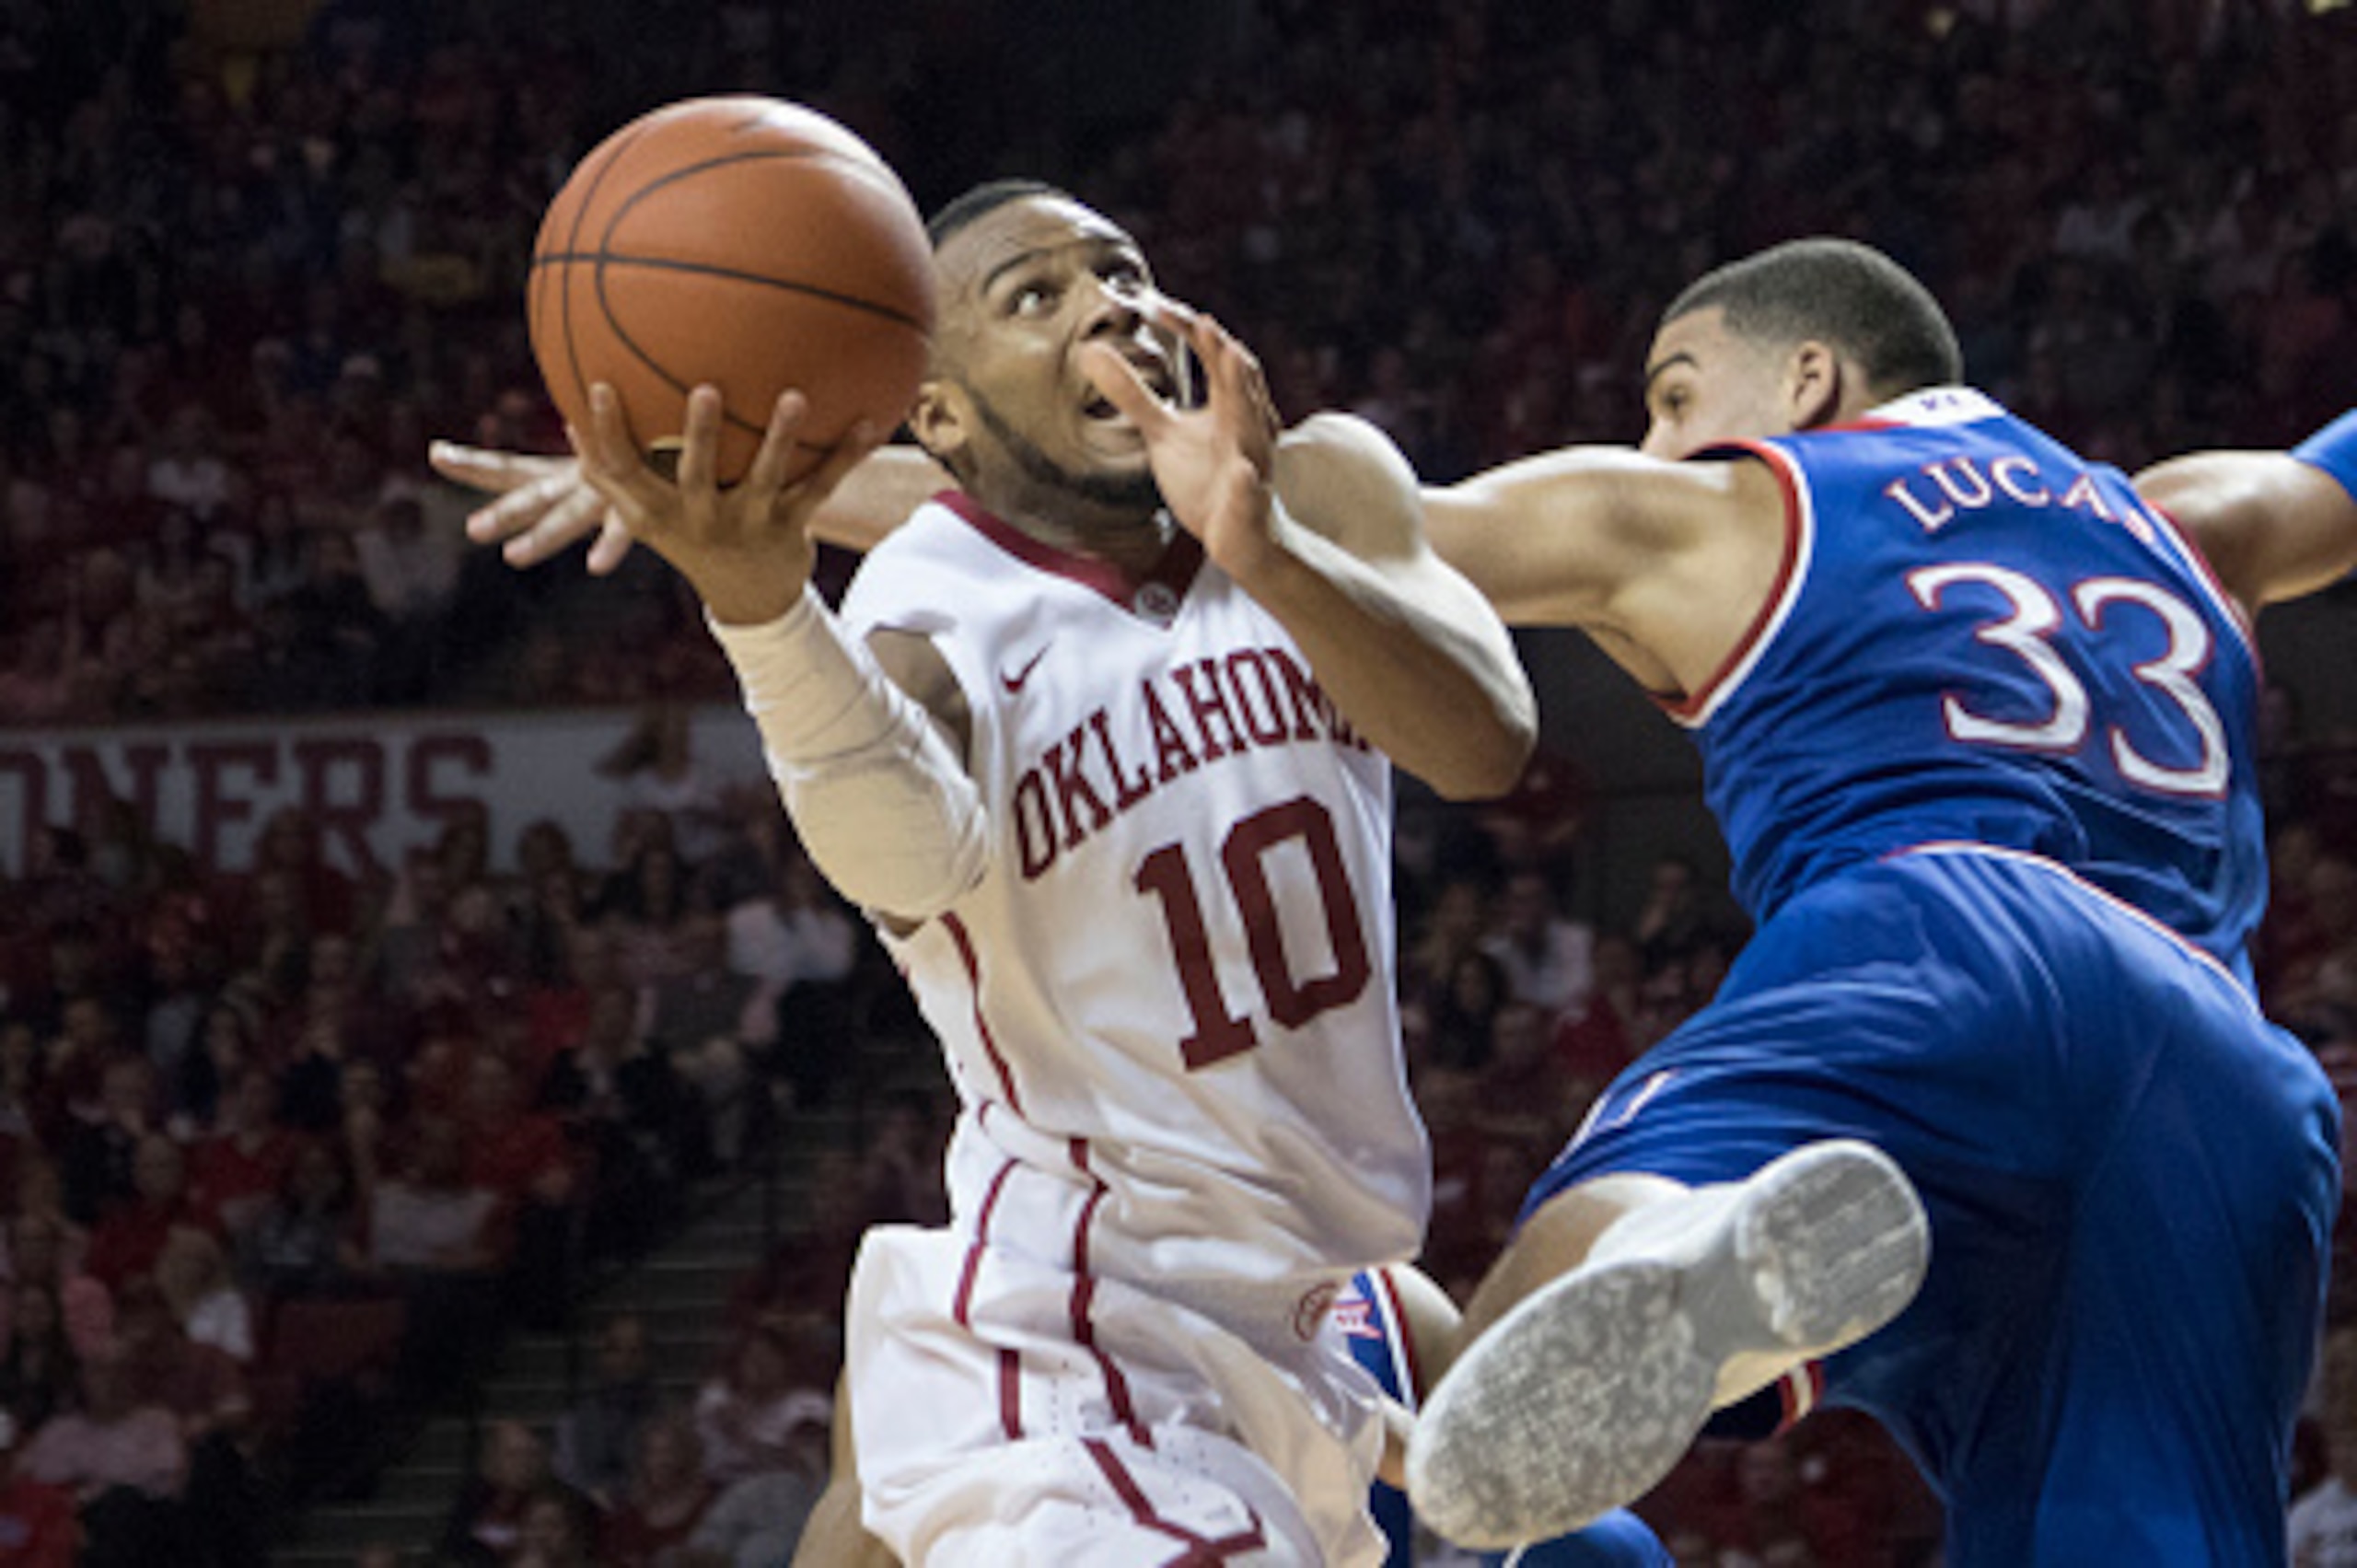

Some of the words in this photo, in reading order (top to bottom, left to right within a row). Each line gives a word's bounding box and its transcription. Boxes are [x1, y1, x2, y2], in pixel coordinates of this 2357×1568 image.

[1014, 647, 1370, 881] OKLAHOM
[1905, 563, 2230, 798] 33
[1132, 796, 1372, 1072] 10
